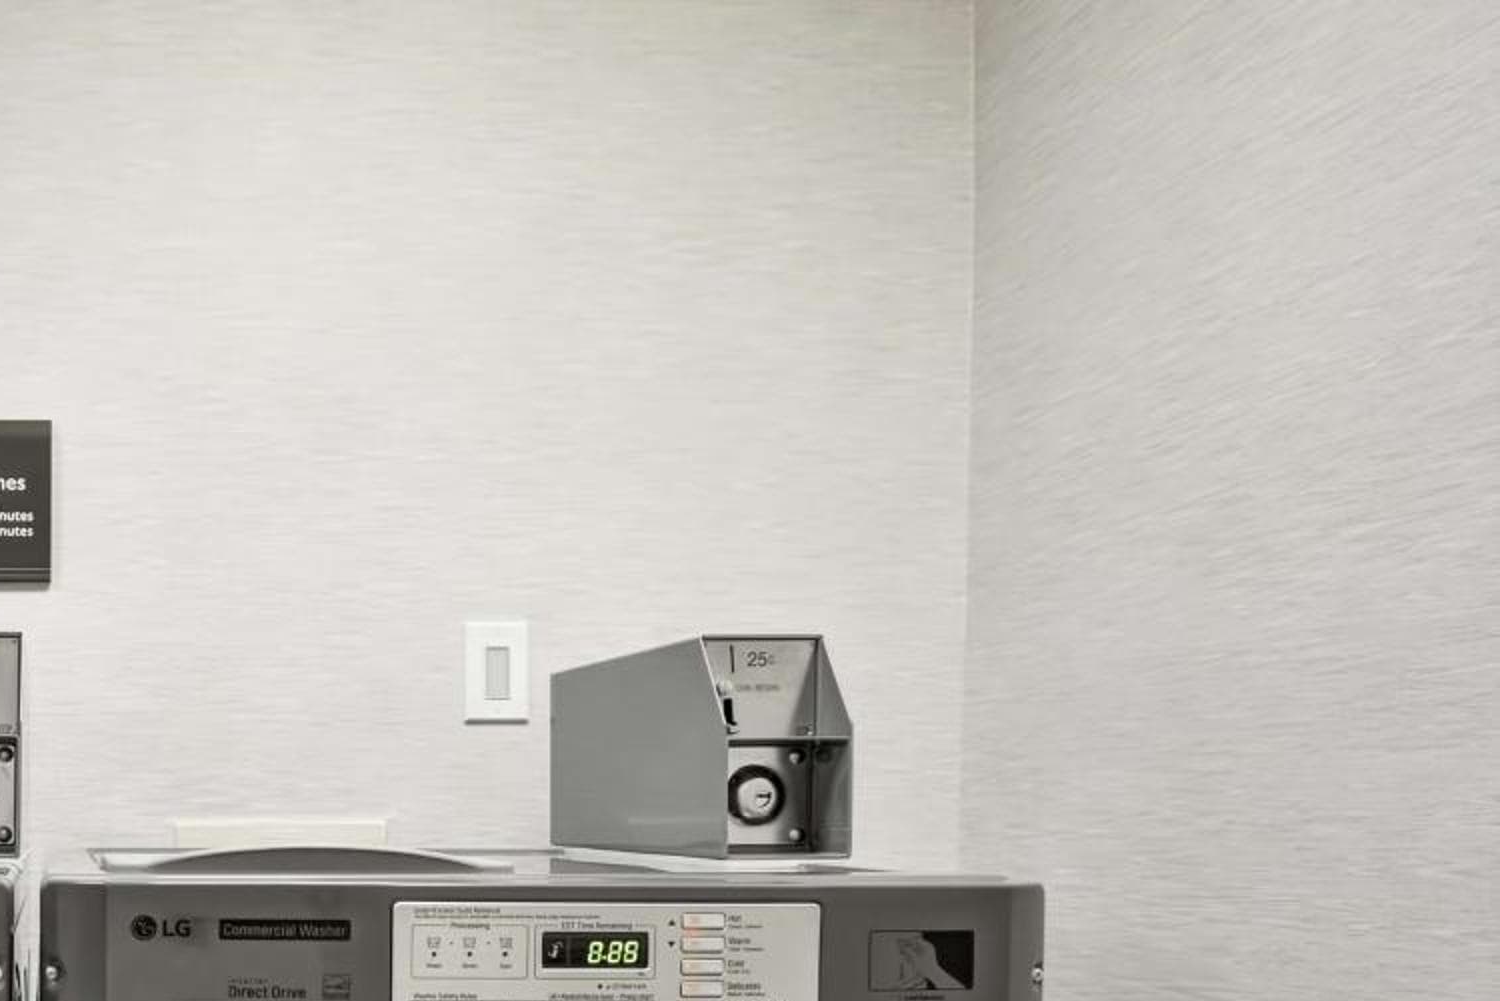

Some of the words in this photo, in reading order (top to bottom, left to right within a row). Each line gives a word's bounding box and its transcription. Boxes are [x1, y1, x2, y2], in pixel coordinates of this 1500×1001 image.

[162, 920, 191, 937] LG
[223, 922, 297, 936] Commercial
[299, 922, 347, 938] Washer
[228, 986, 268, 998] Direct
[271, 986, 307, 998] Drive
